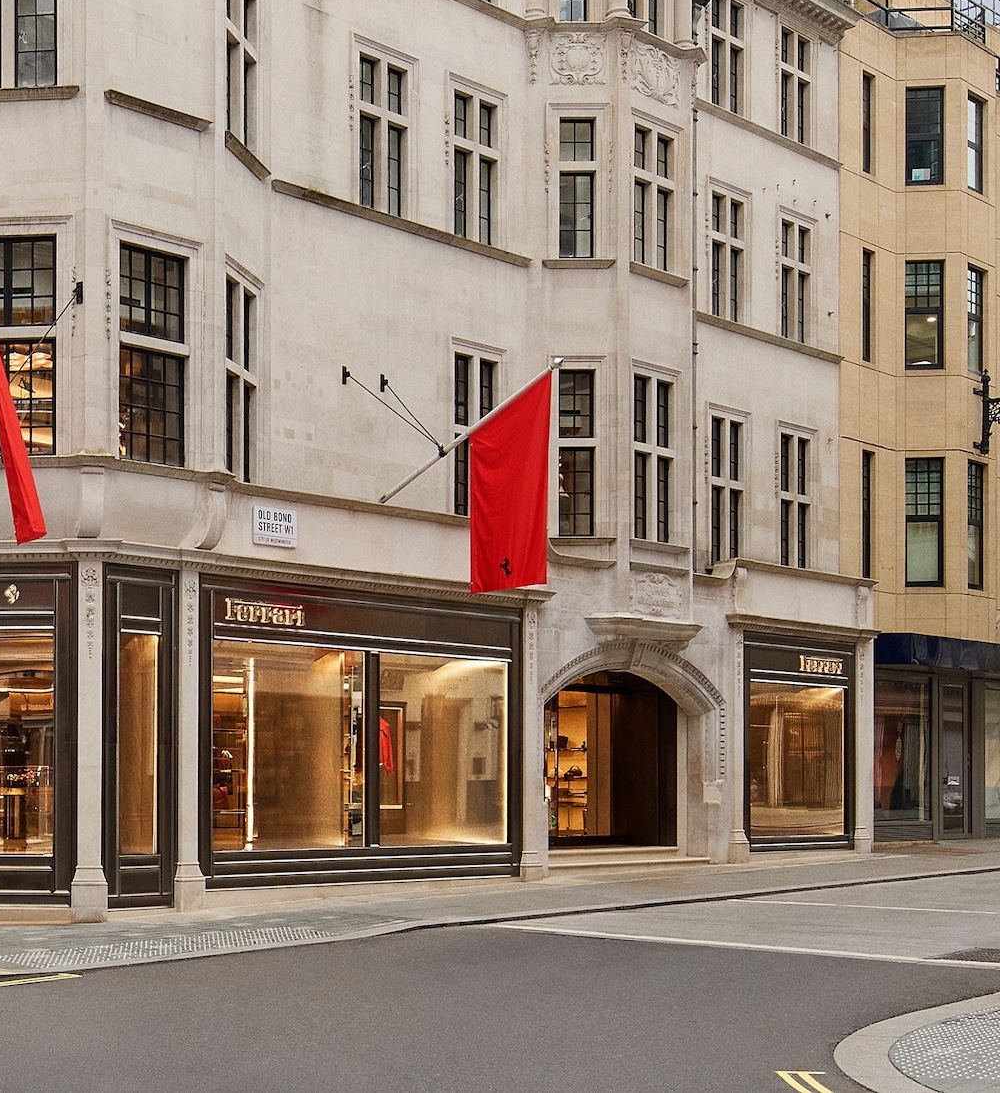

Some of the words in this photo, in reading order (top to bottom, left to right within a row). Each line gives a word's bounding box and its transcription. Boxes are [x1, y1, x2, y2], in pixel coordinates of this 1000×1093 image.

[258, 509, 271, 521] OLD
[273, 512, 292, 523] BOND
[258, 521, 282, 534] STREET
[284, 524, 294, 535] W1
[225, 597, 306, 627] Ferrari
